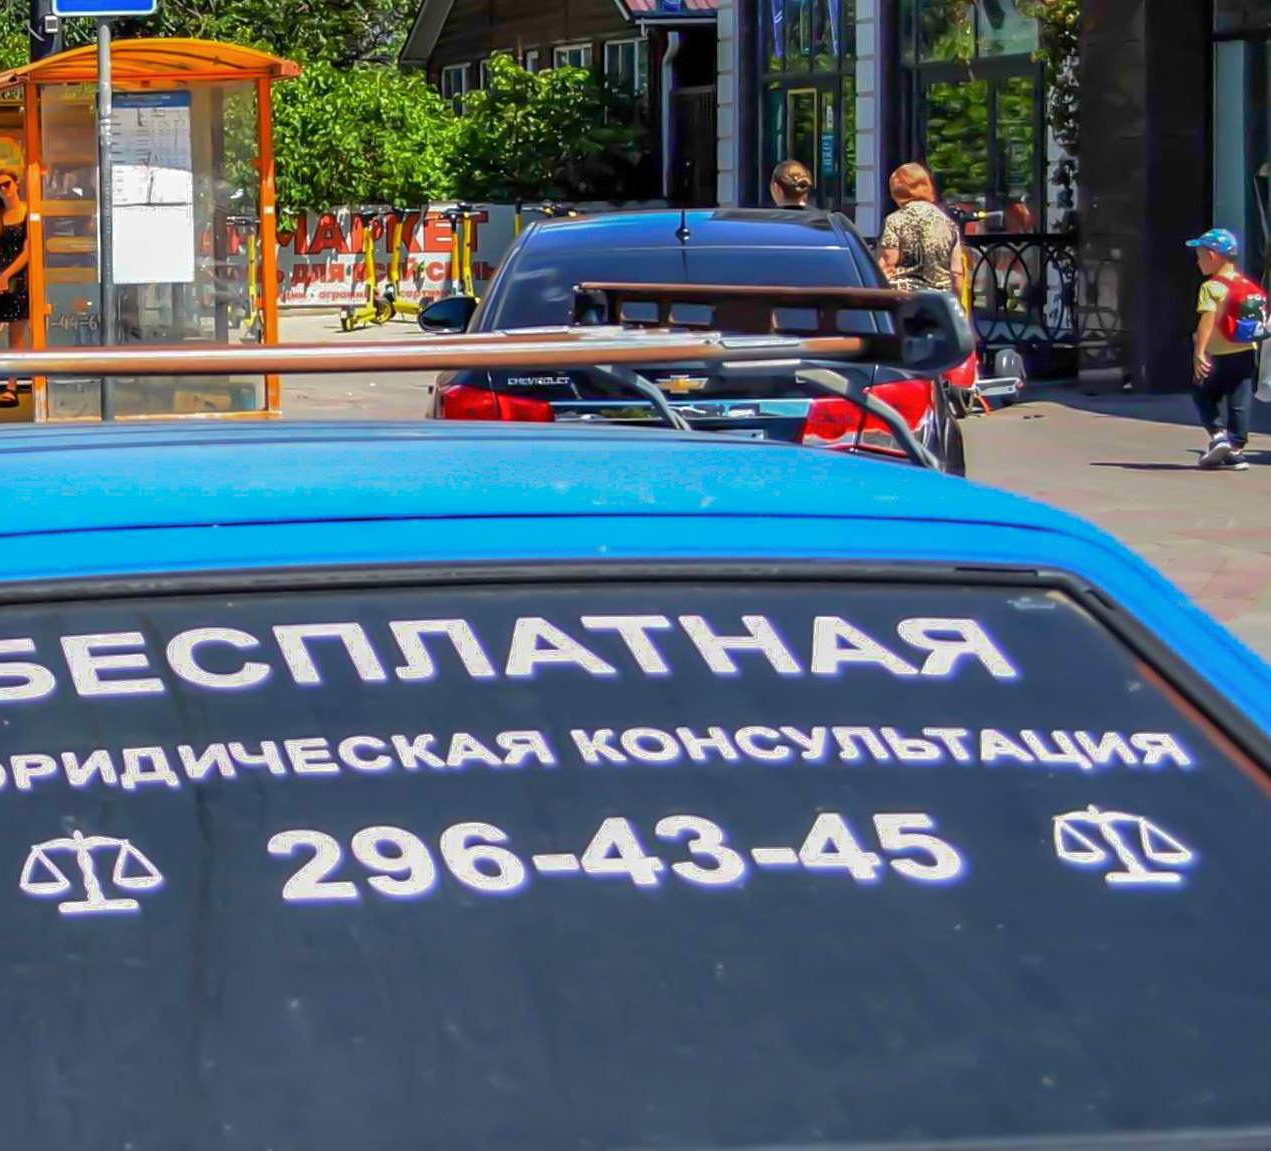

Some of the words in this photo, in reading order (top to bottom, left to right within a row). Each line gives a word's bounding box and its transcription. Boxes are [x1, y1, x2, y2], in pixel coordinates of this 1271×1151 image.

[507, 376, 570, 386] CHEVROLET
[570, 725, 1192, 769] КОНСУЛЬТАЦИЯ
[266, 812, 962, 902] 296-43-45
